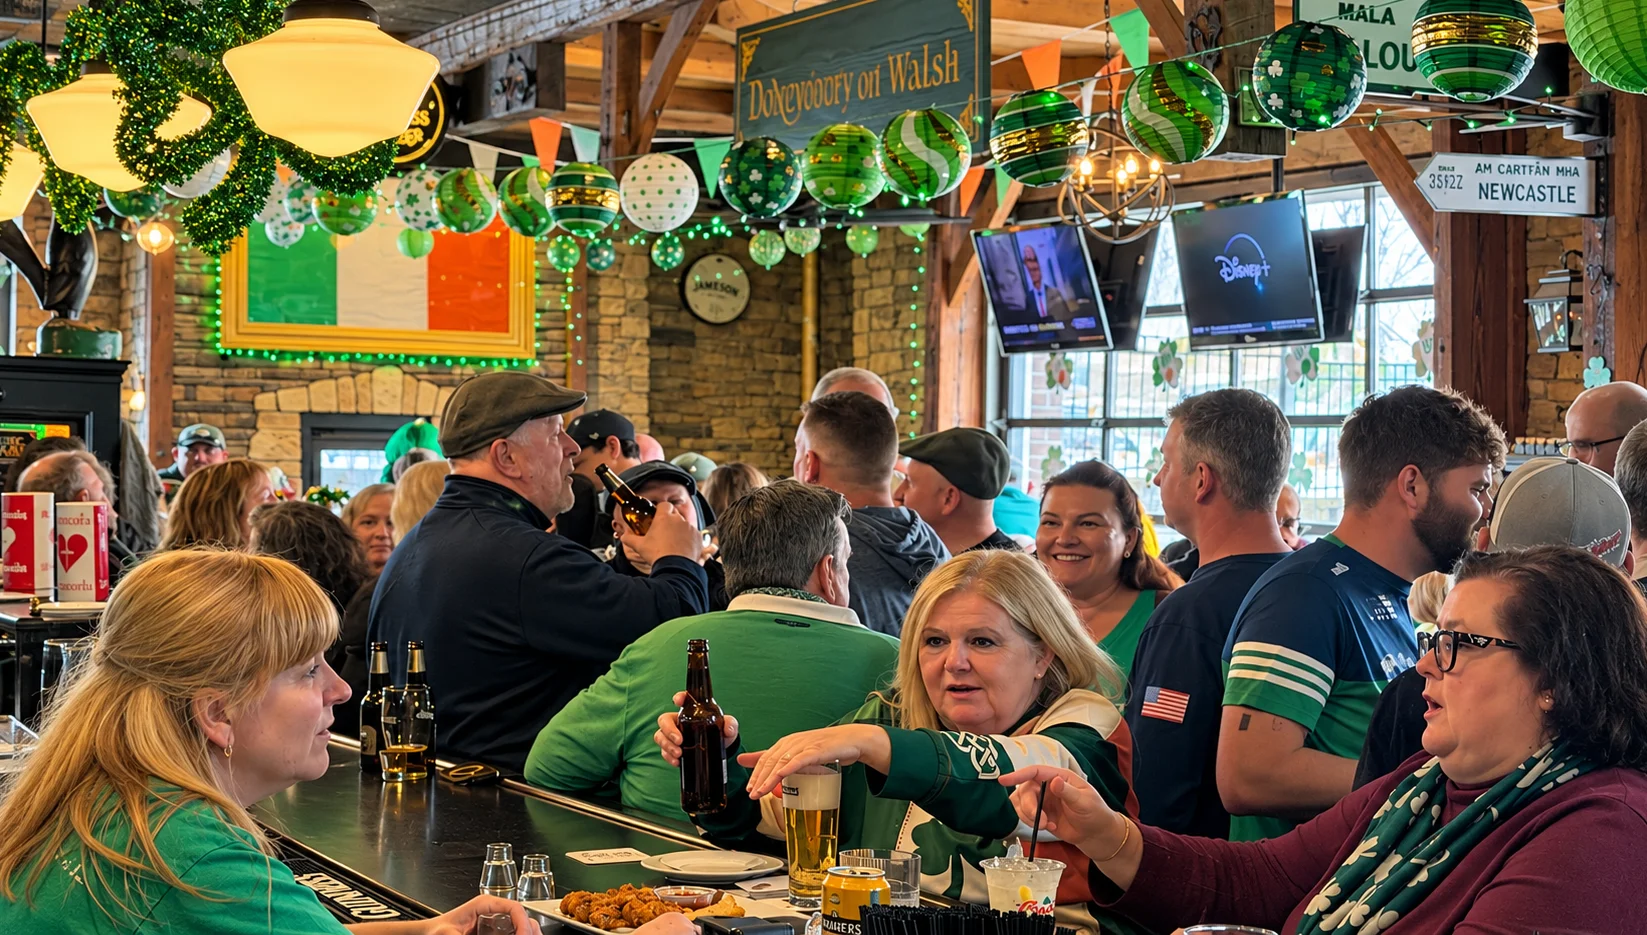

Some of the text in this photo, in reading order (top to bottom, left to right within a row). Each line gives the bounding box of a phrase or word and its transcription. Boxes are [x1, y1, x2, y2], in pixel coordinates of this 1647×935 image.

[1338, 2, 1396, 25] MALA
[887, 40, 960, 95] Walsh
[1475, 163, 1492, 174] AM
[1556, 166, 1580, 177] MHA
[1479, 182, 1576, 203] NEWCASTLE
